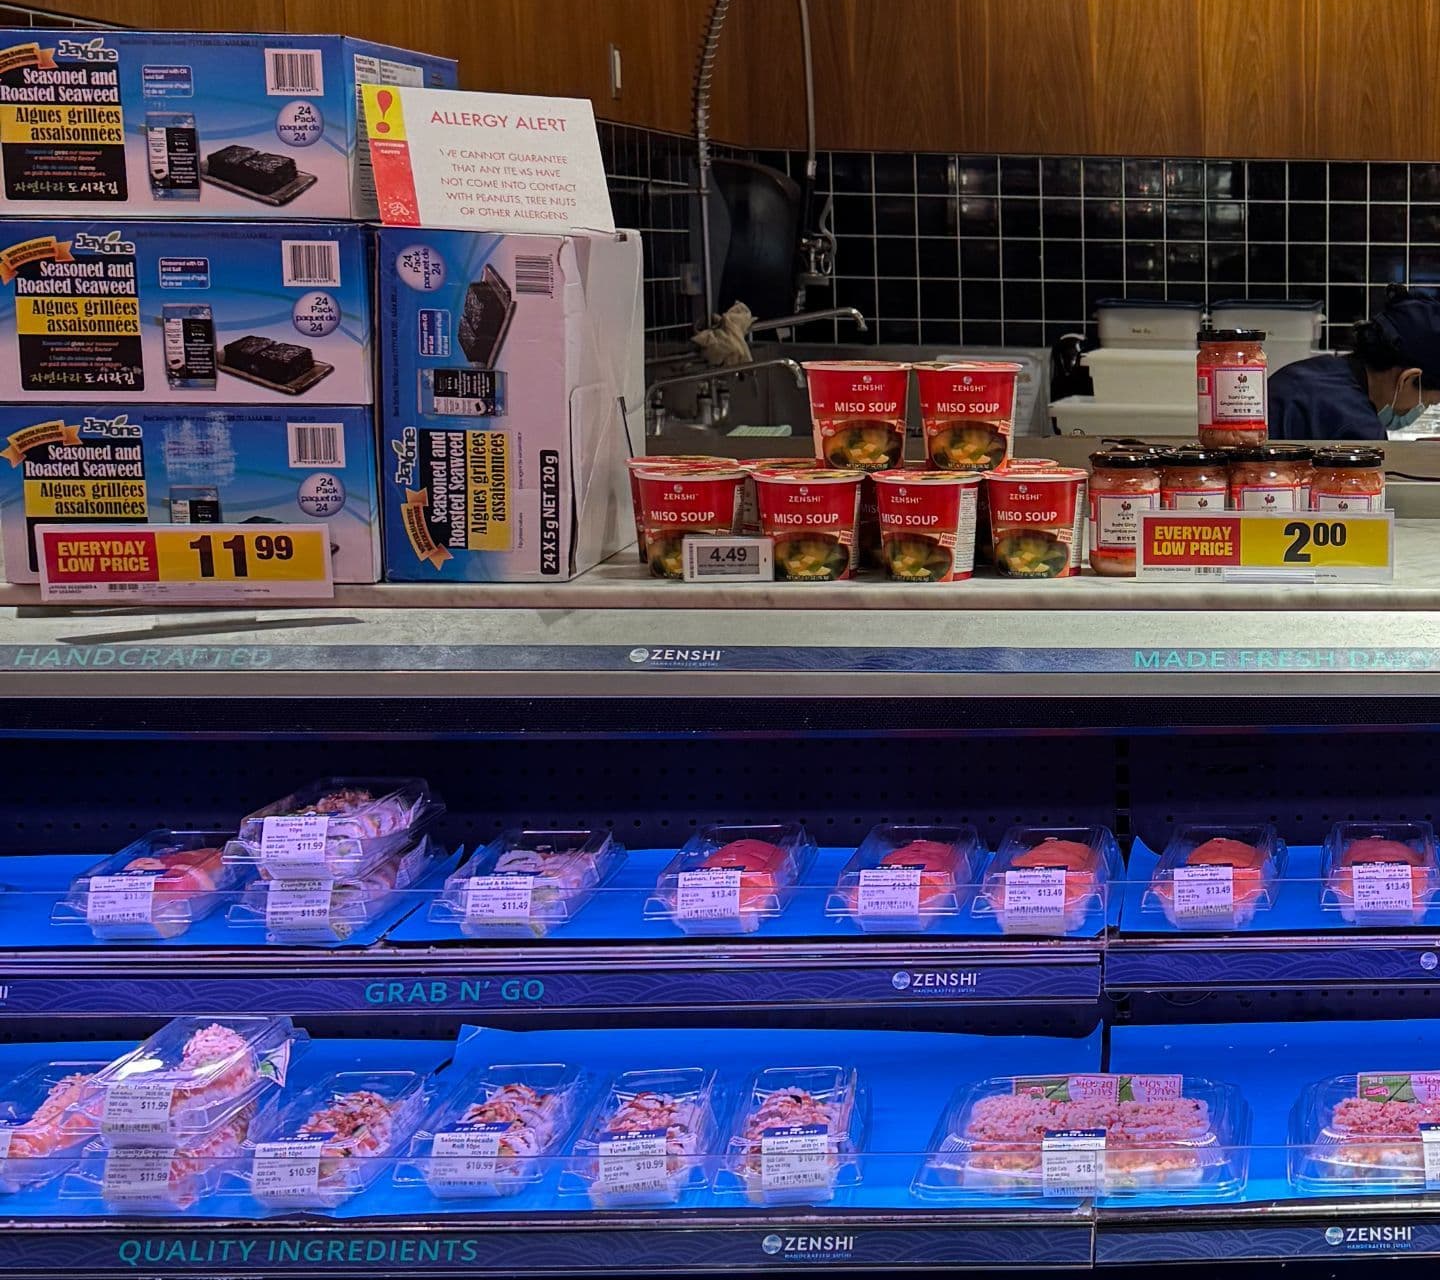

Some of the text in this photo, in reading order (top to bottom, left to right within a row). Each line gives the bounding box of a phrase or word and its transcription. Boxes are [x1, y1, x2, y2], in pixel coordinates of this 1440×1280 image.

[23, 68, 118, 86] Seasoned and
[1, 85, 119, 103] Roasted Seaweed
[15, 106, 121, 127] Algues grillées
[298, 105, 312, 116] 24
[294, 114, 318, 124] Pack
[430, 110, 567, 132] ALLERGY ALERT
[30, 124, 123, 143] assaisonnées
[460, 150, 507, 161] CANNOT
[509, 152, 568, 165] GUARANTEE
[452, 163, 561, 178] THAT ANY ITEMS HAVE
[441, 177, 577, 193] NOT COME INTO CONTACT
[446, 192, 577, 207] WITH PEANUTS, TREE NUTS
[460, 206, 569, 220] OR OTHER ALLERGENS
[40, 261, 134, 278] Seasoned and
[17, 278, 135, 295] Roasted Seaweed
[32, 299, 79, 318] Algues
[84, 298, 138, 318] grillées
[47, 315, 139, 333] assaisonnées
[852, 384, 884, 392] ZENSHI
[834, 401, 898, 414] MISO SOUP
[936, 402, 1000, 414] MISO SOUP
[543, 455, 559, 569] 24 X 5 g NET 120 g
[651, 510, 715, 522] MISO SOUP
[774, 513, 839, 525] MISO SOUP
[881, 513, 939, 526] MISO SOUP
[996, 510, 1058, 522] MISO SOUP
[1154, 526, 1232, 541] EVERYDAY
[58, 541, 146, 557] EVERYDAY
[709, 547, 748, 564] 4.49
[1153, 542, 1233, 556] LOW PRICE
[58, 557, 150, 572] LOW PRICE
[14, 647, 274, 667] HANDCRAFTED
[651, 649, 722, 662] ZENSHI
[1133, 650, 1228, 668] MADE
[1239, 650, 1336, 668] FRESH
[711, 889, 737, 899] $13.49
[913, 973, 977, 986] ZENSHI
[364, 981, 448, 1004] GRAB
[501, 979, 546, 1002] GO
[140, 1100, 169, 1111] $11.99
[140, 1172, 168, 1182] $11.99
[289, 1167, 317, 1178] $10.99
[1343, 1227, 1414, 1243] ZENSHI
[784, 1236, 855, 1252] ZENSHI
[118, 1237, 478, 1267] QUALITY INGREDIENTS
